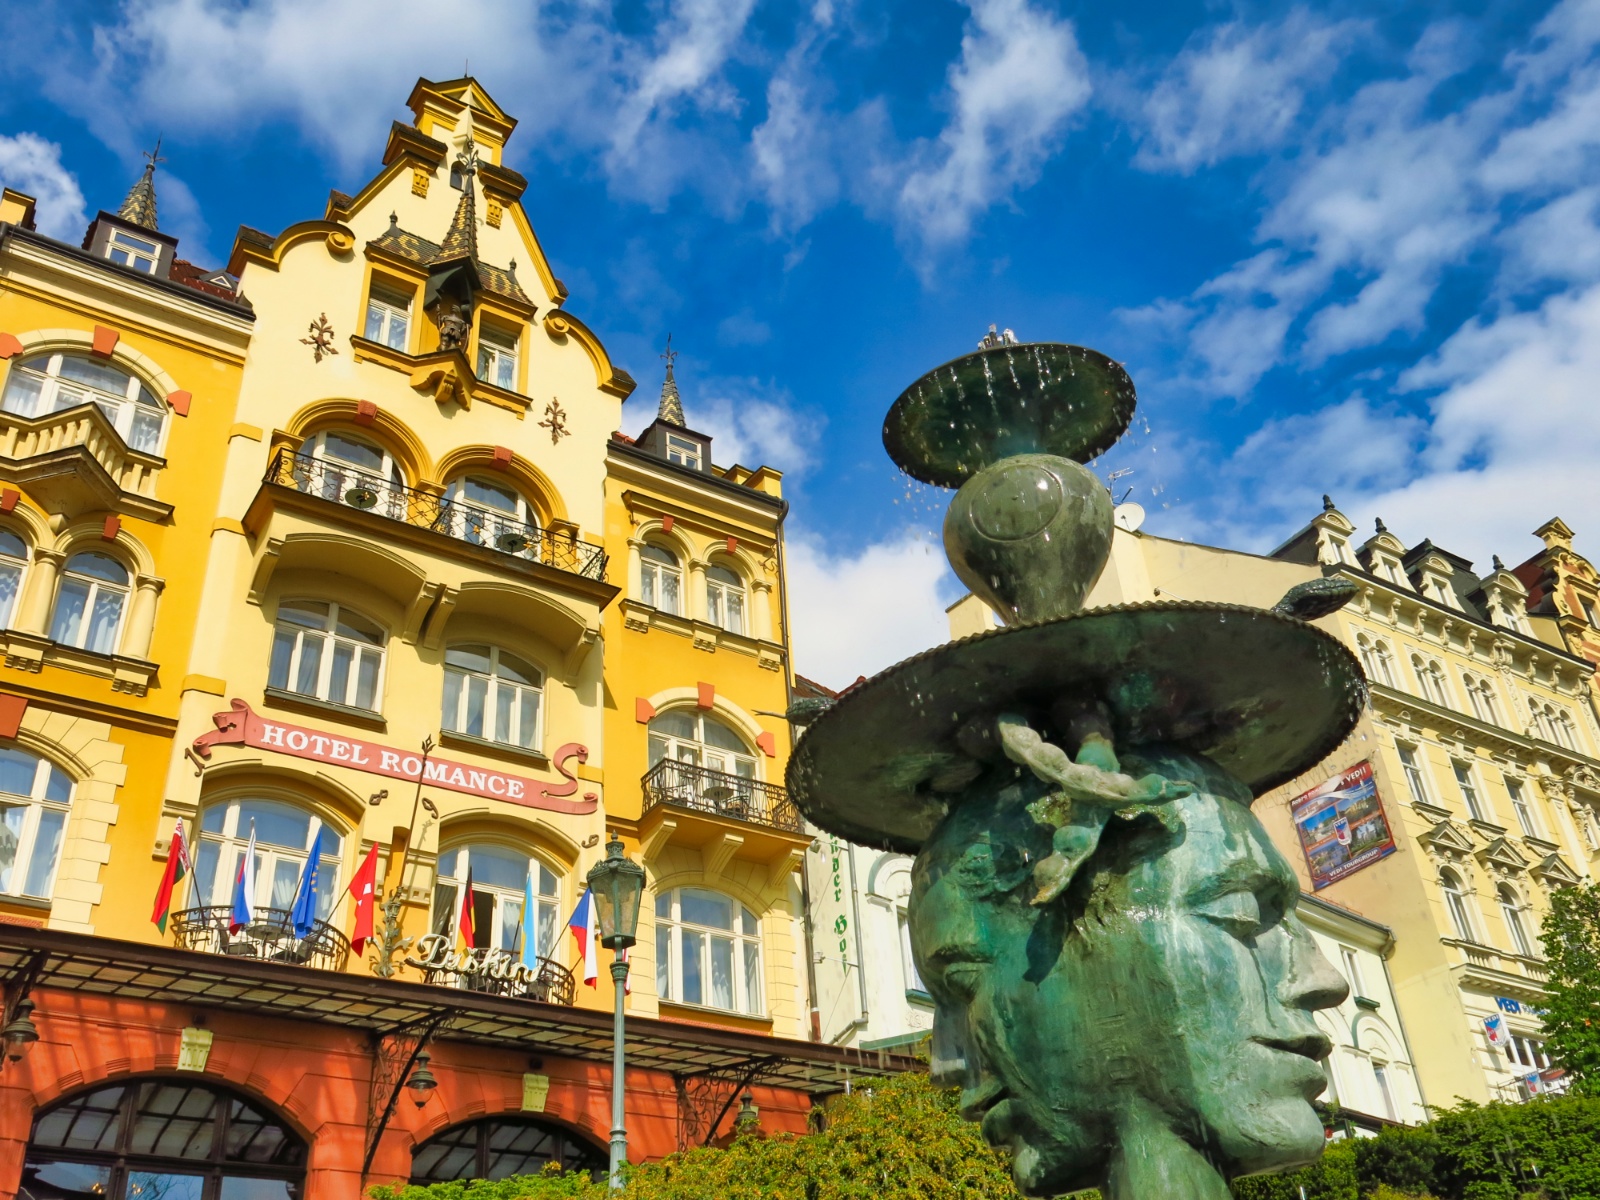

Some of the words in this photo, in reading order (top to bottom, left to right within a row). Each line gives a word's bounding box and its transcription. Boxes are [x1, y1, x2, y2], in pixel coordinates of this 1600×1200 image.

[261, 723, 370, 766] HOTEL
[379, 750, 525, 799] ROMANCE
[1329, 867, 1343, 877] VEDI
[1343, 849, 1378, 870] TOURGROUP
[1494, 996, 1521, 1015] VEDI
